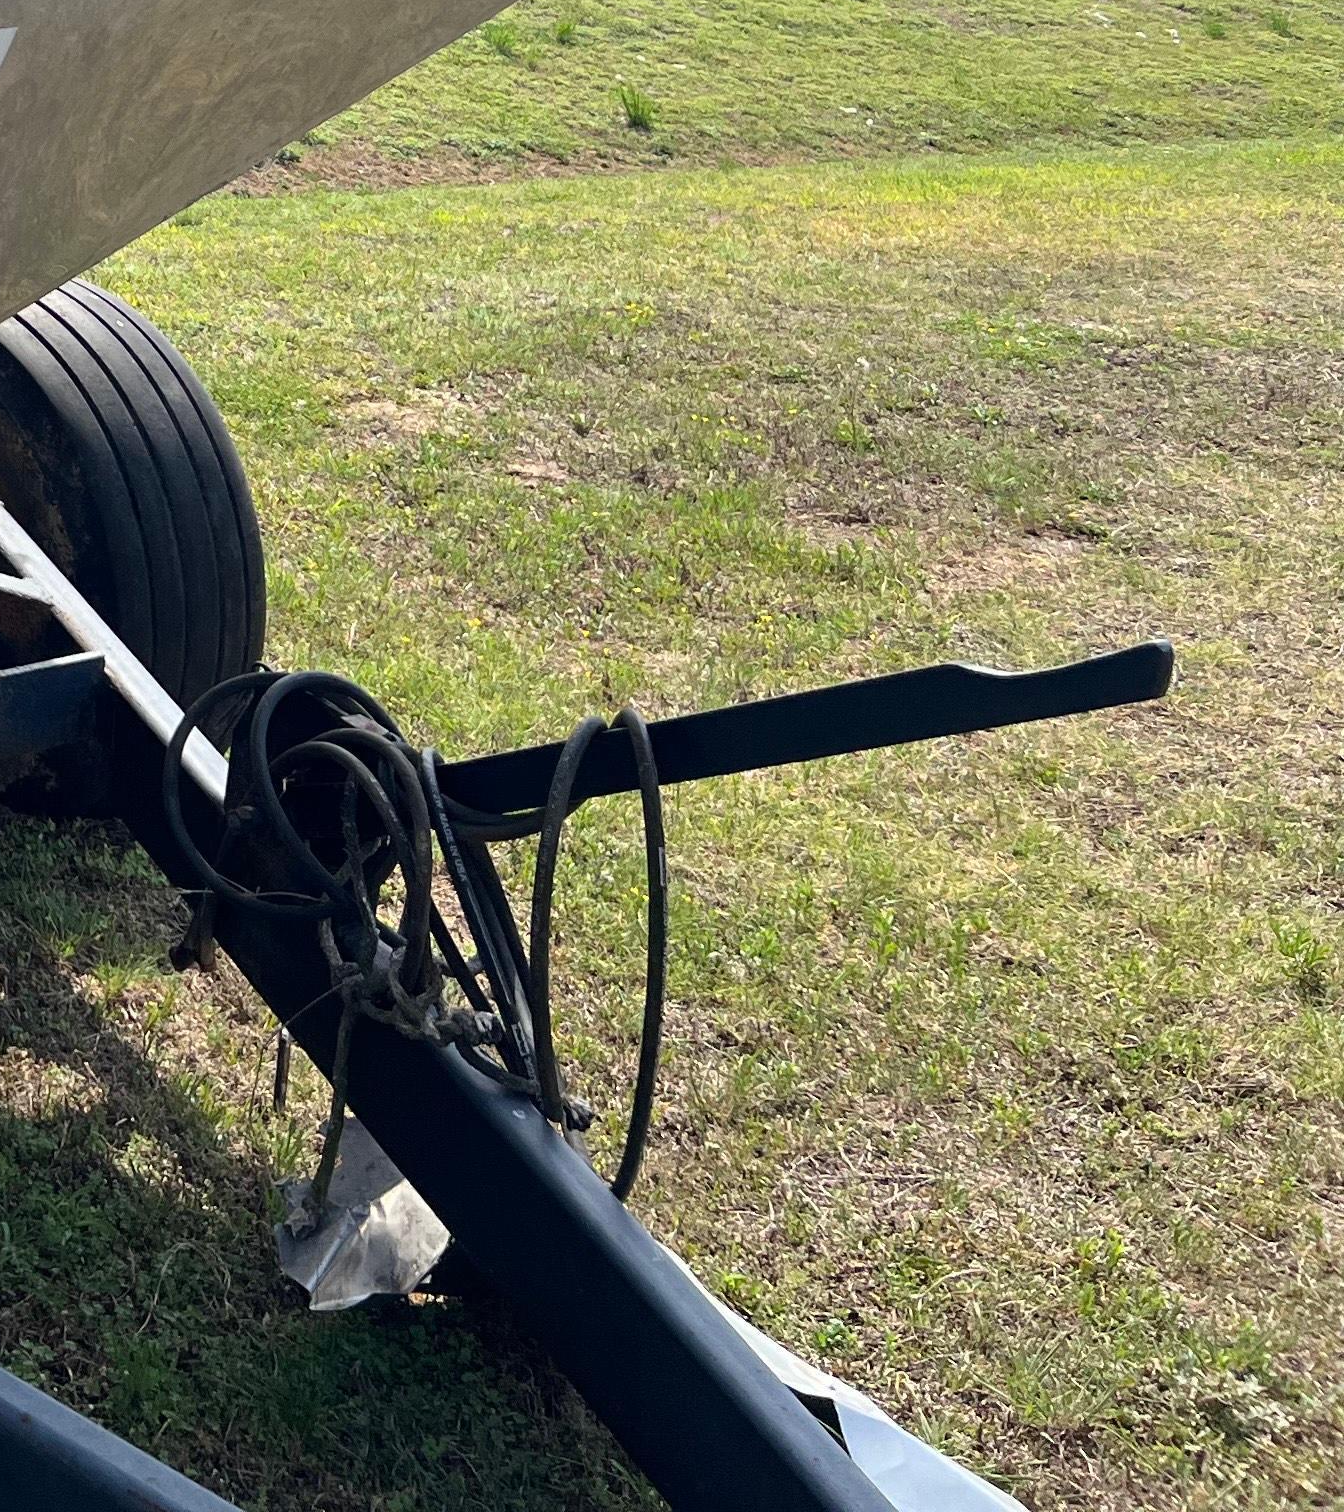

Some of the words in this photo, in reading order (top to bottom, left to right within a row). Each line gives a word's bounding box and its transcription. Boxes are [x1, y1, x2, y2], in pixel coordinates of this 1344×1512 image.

[438, 812, 455, 843] MADE
[450, 845, 461, 856] IN
[454, 858, 470, 882] USA
